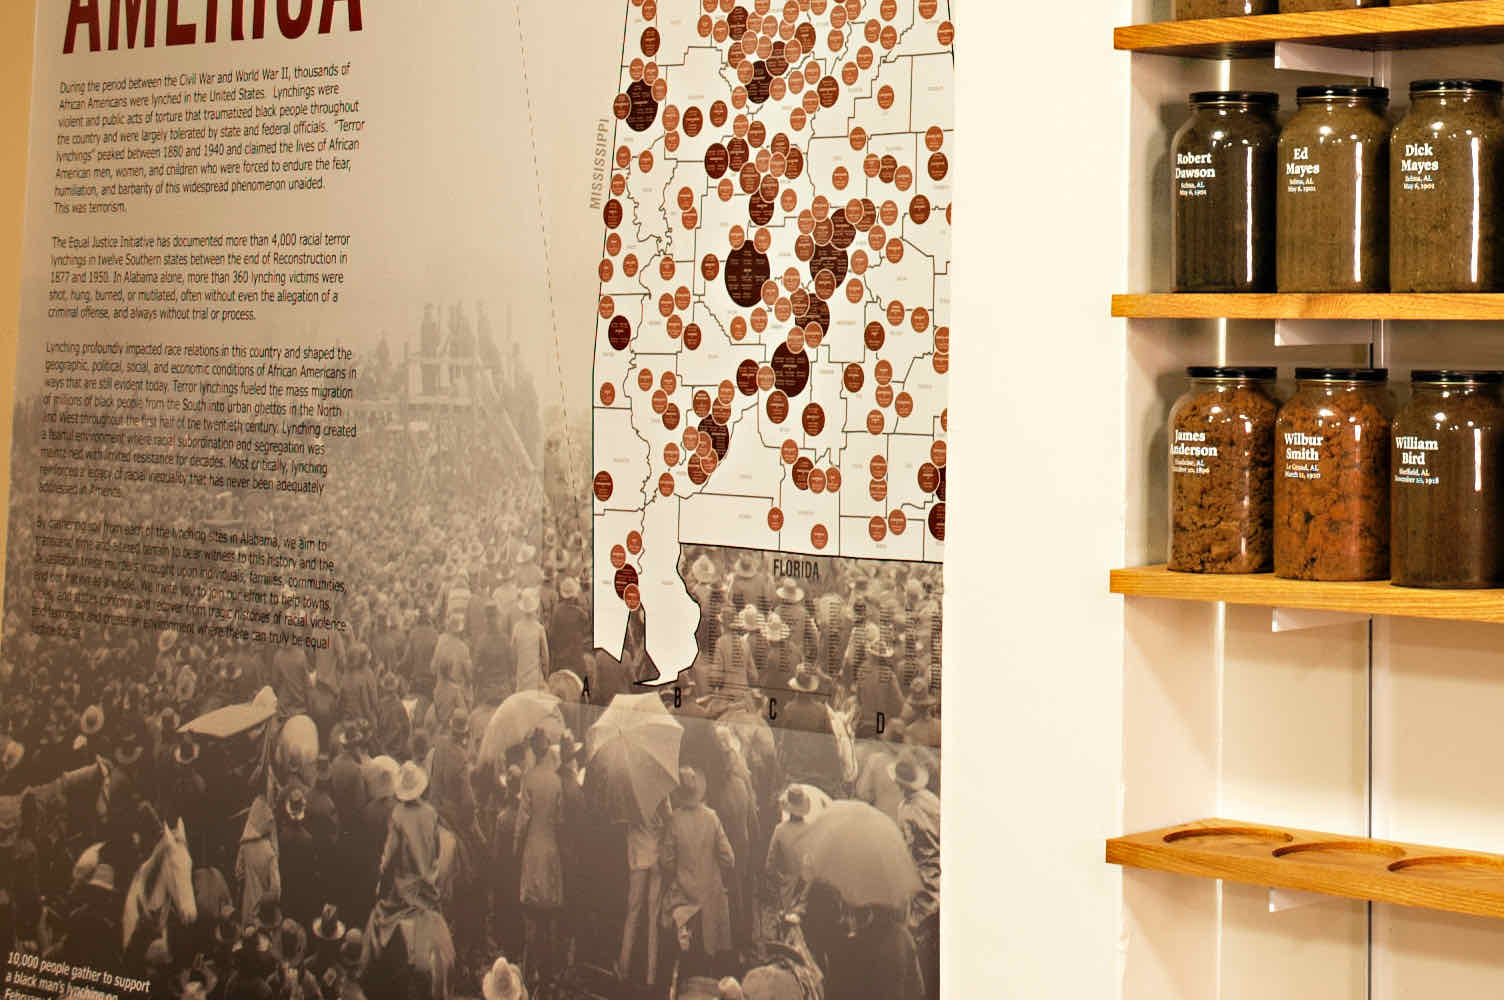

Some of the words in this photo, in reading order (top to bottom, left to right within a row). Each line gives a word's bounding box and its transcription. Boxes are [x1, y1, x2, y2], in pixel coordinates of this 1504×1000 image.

[589, 118, 610, 210] MISSISSIPPI
[1176, 152, 1212, 165] Robert
[1175, 166, 1216, 179] Dawson
[325, 233, 350, 246] terror
[273, 251, 337, 265] Reconstruction
[1284, 433, 1323, 447] Wilbur
[1395, 436, 1439, 451] William
[1286, 447, 1319, 461] Smith
[1401, 451, 1426, 465] Bird
[773, 559, 819, 581] FLORIDA
[7, 951, 39, 969] 10,000
[40, 960, 70, 976] people
[71, 966, 101, 981] gather
[104, 970, 113, 984] to
[114, 975, 150, 992] support
